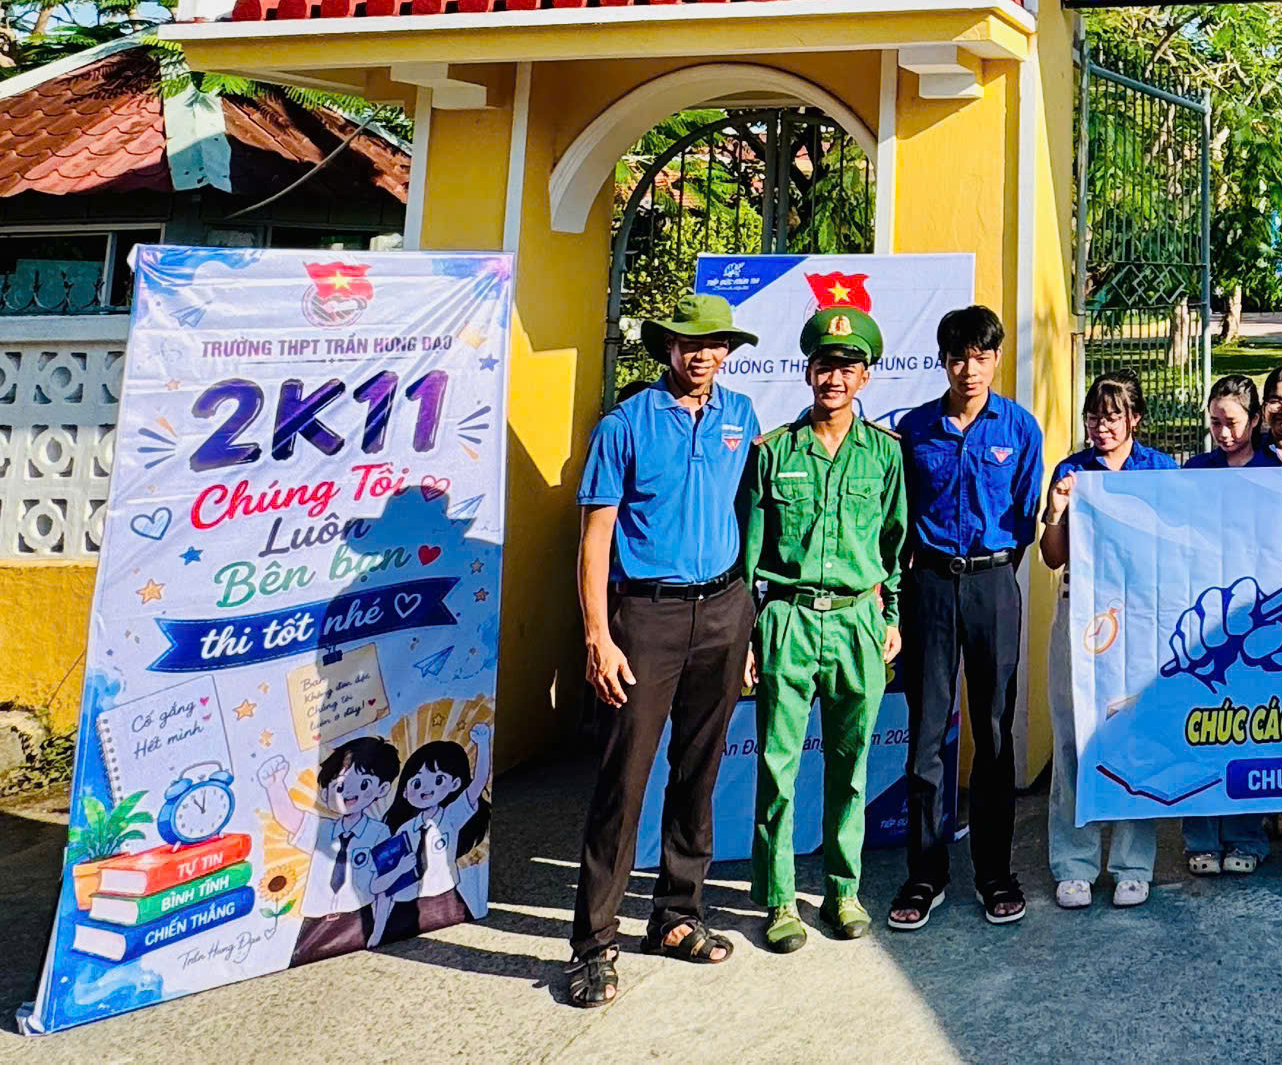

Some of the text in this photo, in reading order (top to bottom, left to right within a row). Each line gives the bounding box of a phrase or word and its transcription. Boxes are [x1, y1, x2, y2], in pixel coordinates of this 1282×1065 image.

[201, 336, 273, 358] TRƯỜNG
[277, 338, 321, 356] THPT
[718, 355, 774, 376] RƯỜNG
[922, 355, 944, 373] ĐẠ
[189, 369, 449, 473] 2K11
[190, 462, 411, 530] Chúng Tôi
[258, 511, 371, 558] Luôn
[214, 543, 412, 608] Bên bạn
[200, 597, 385, 660] thi tốt nhé
[131, 701, 196, 733] Cố gắng
[884, 729, 910, 745] 202
[1186, 697, 1250, 746] CHÚC
[133, 736, 162, 760] Hết
[177, 851, 224, 878] TỰ TIN
[160, 874, 230, 912] BÌNH TĨNH
[144, 901, 236, 947] CHIẾN THẮNG
